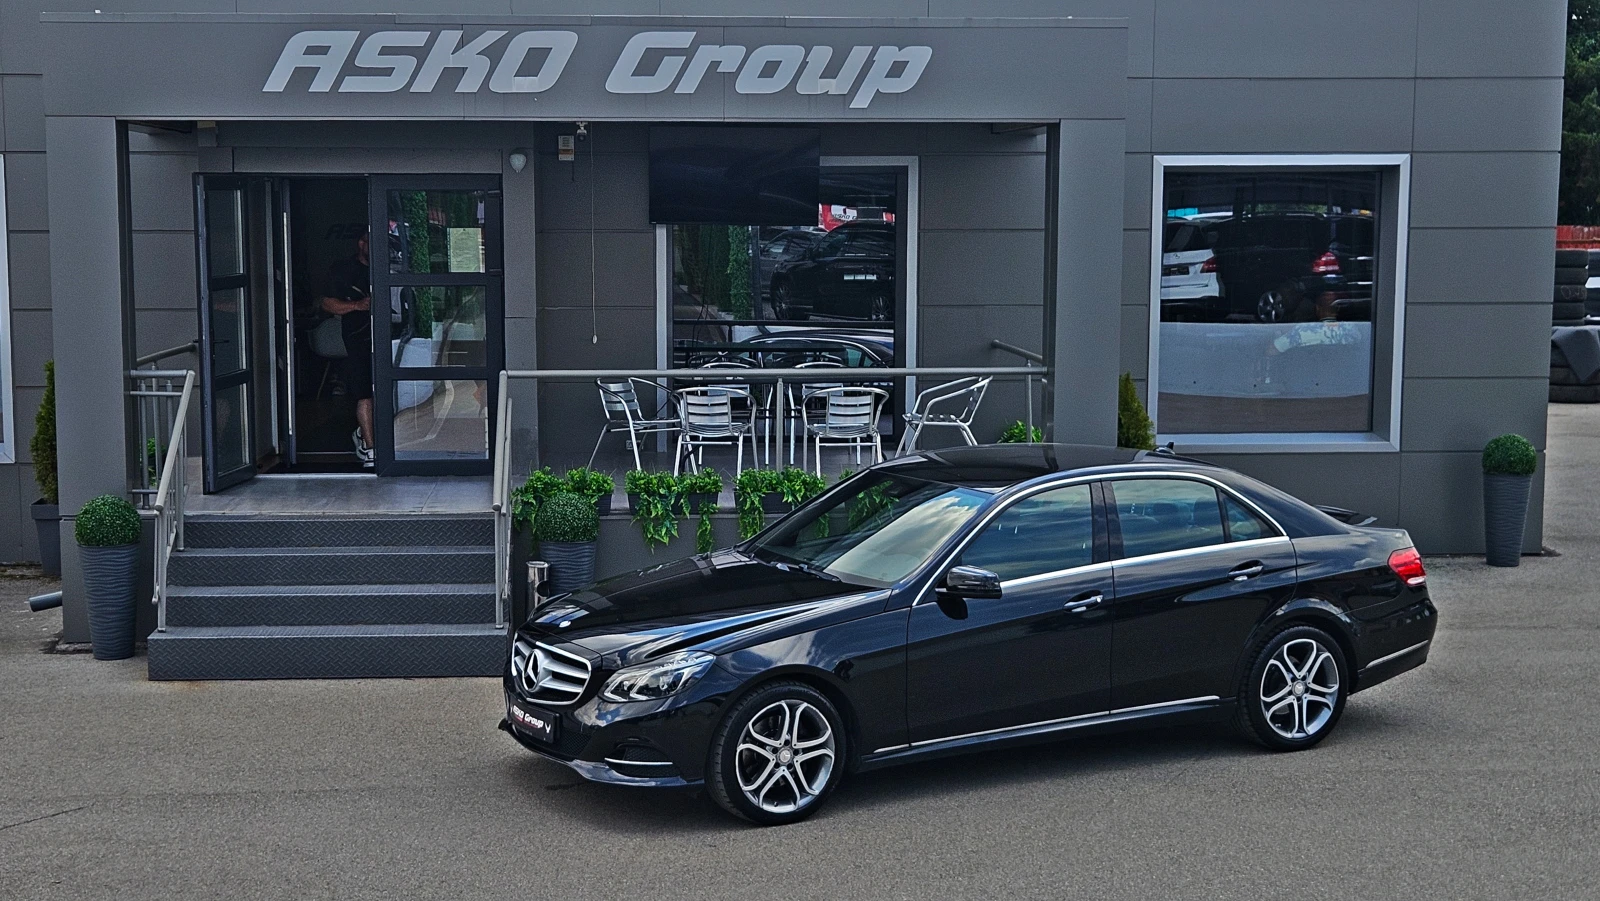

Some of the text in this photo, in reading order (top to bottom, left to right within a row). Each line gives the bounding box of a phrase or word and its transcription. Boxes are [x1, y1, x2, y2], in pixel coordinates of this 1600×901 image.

[262, 30, 933, 109] ASKO Group
[324, 223, 368, 240] AS
[524, 713, 544, 728] Group
